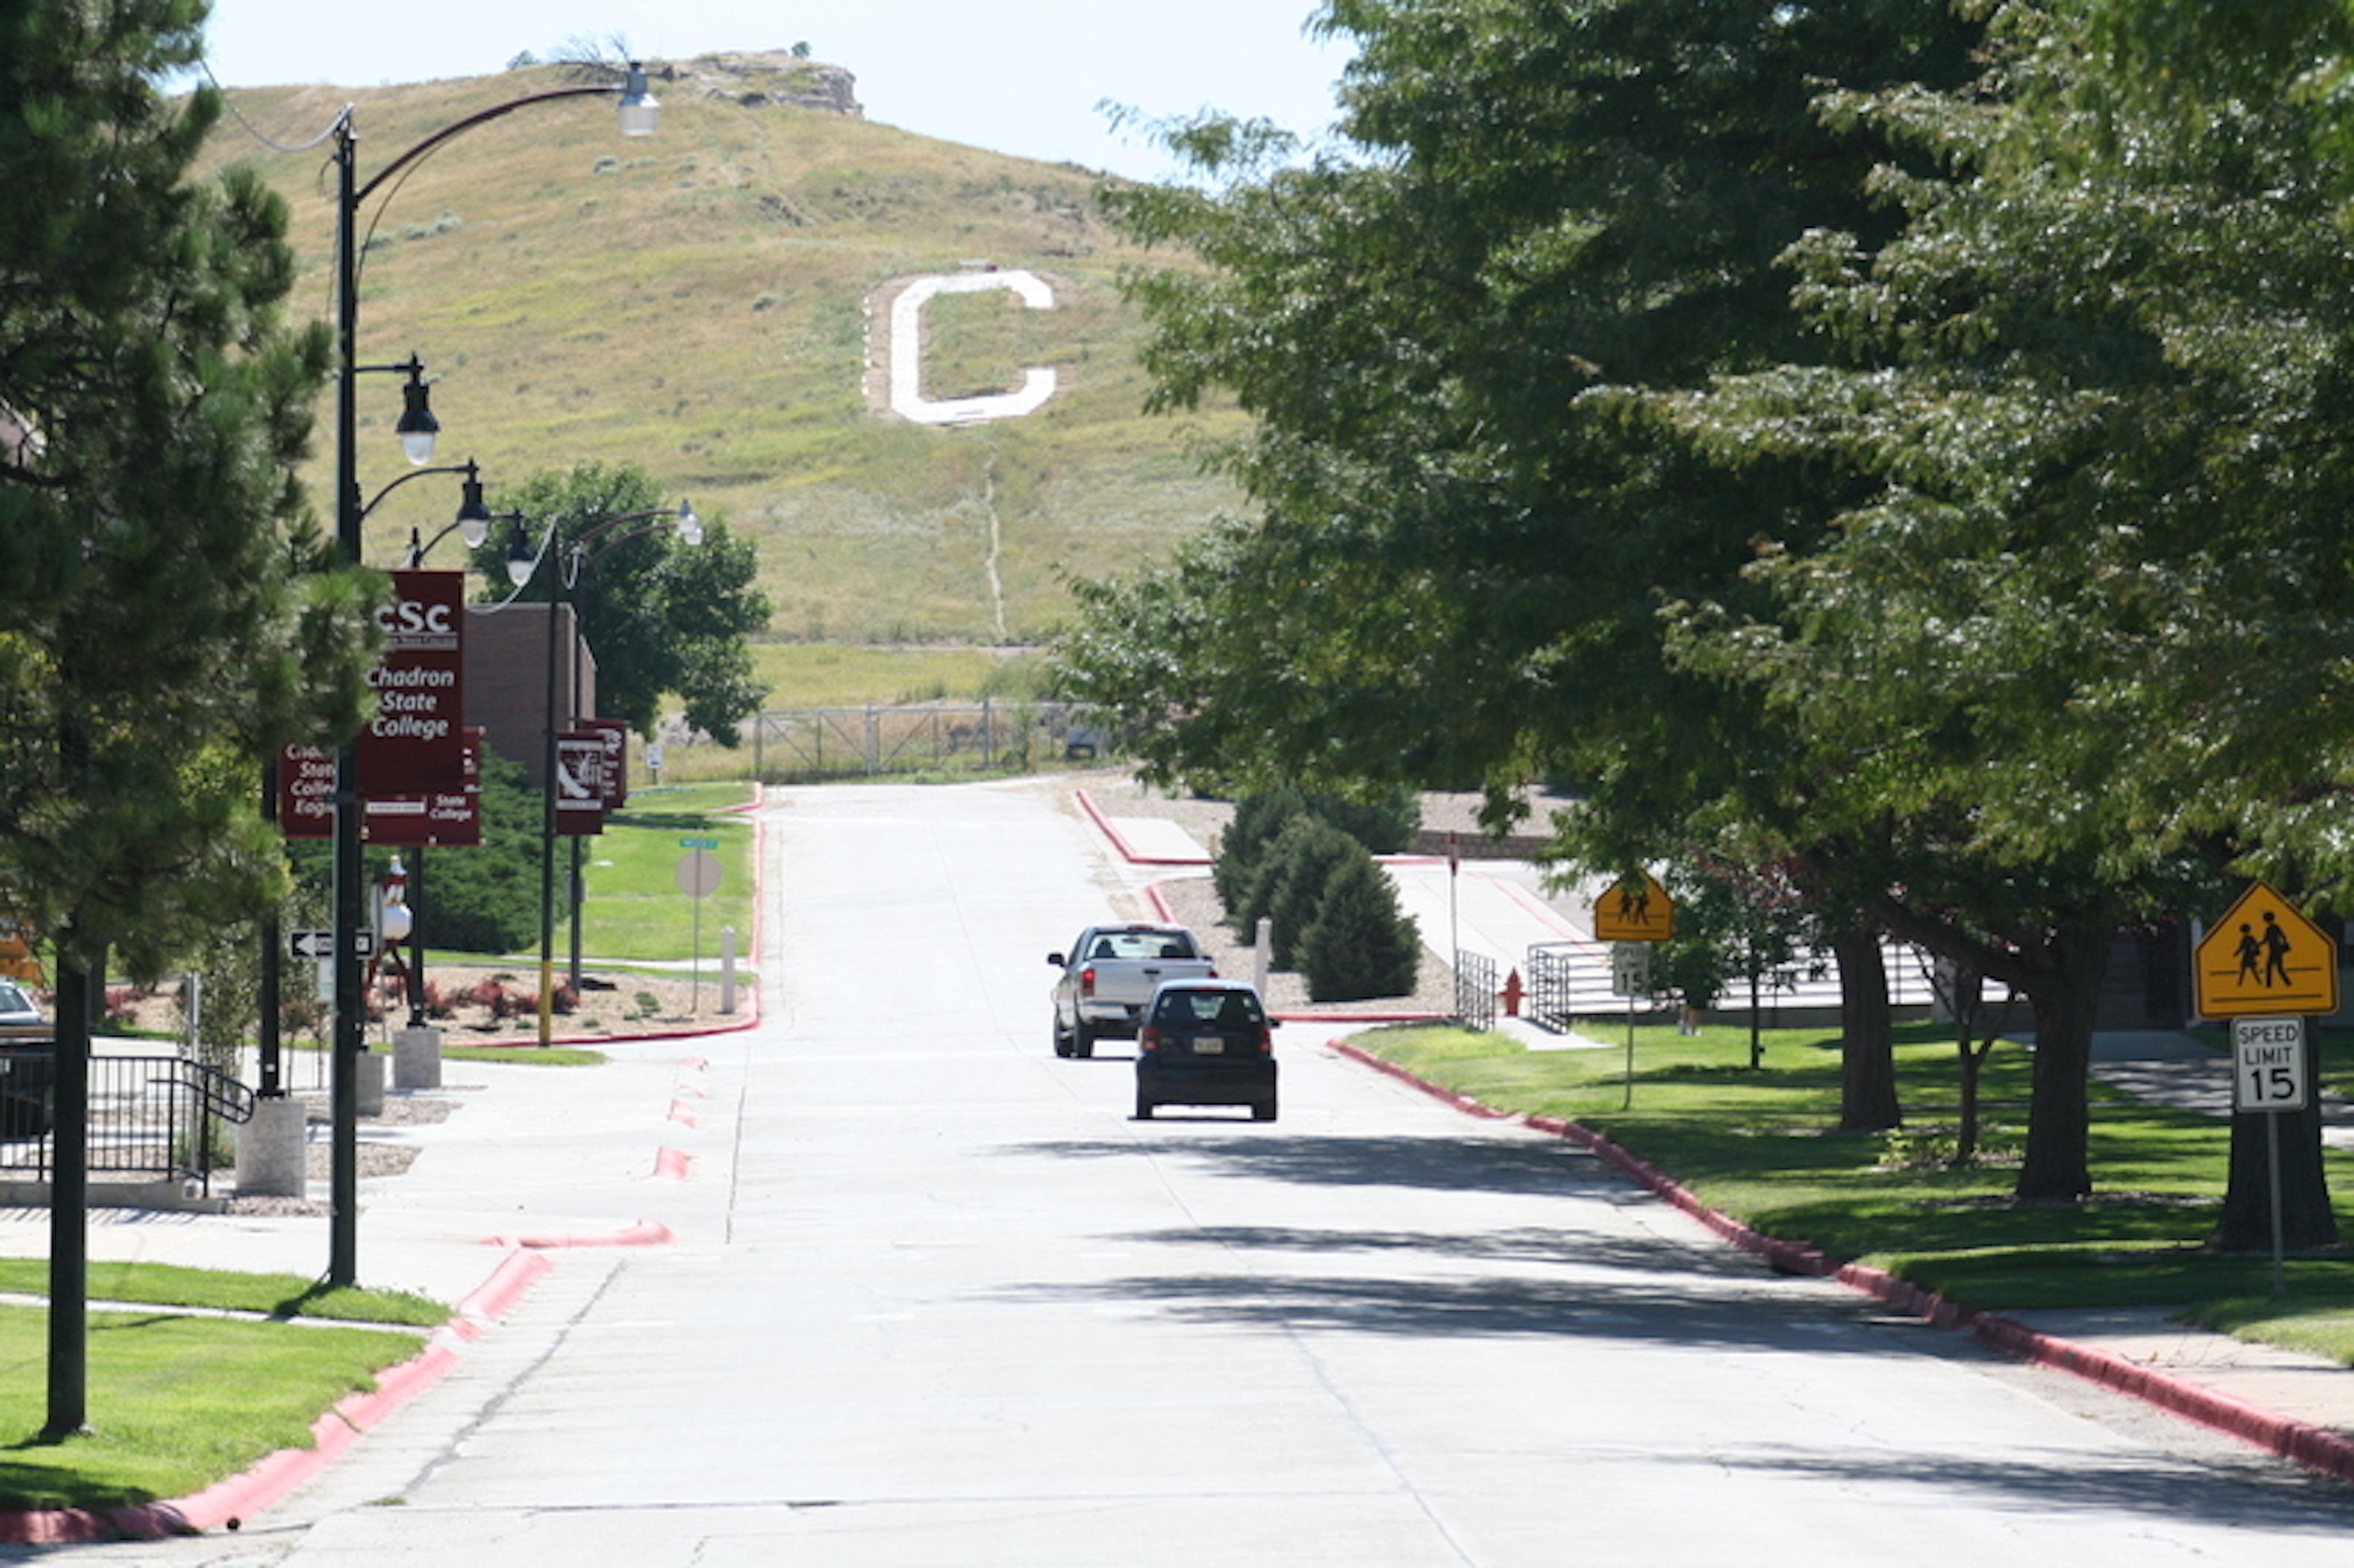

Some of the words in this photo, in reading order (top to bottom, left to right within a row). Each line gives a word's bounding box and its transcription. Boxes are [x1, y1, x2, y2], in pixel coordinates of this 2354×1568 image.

[890, 270, 1057, 423] C
[374, 602, 451, 633] CSC
[365, 666, 455, 686] Chadron
[382, 690, 437, 711] State
[372, 714, 449, 741] College
[1621, 972, 1643, 991] 15
[2239, 1026, 2297, 1044] SPEED
[2244, 1047, 2292, 1065] LIMIT
[2251, 1069, 2295, 1100] 15
